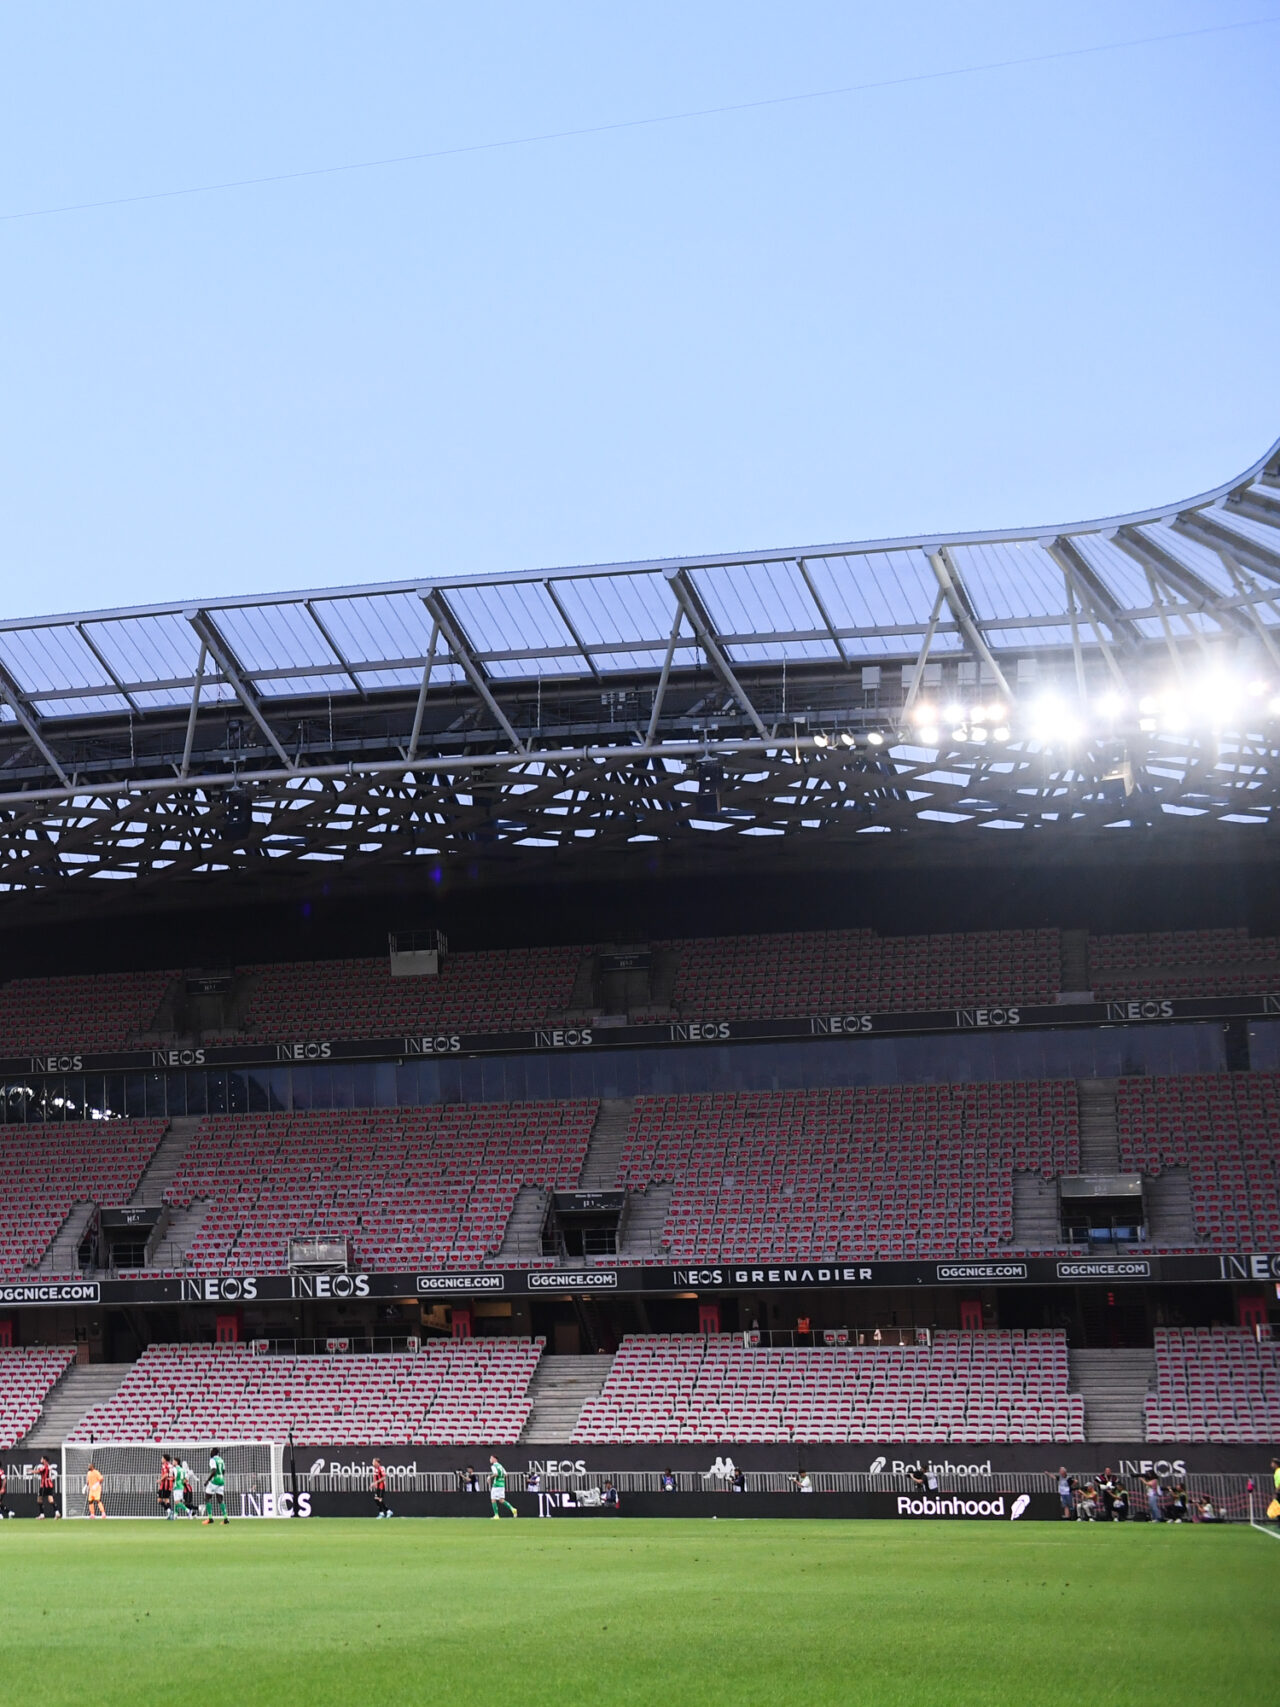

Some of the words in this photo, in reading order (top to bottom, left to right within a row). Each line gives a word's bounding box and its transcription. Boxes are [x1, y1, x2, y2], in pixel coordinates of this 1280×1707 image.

[955, 1008, 1020, 1026] INEOS
[1106, 1001, 1173, 1018] INEOS
[670, 1022, 730, 1040] INEOS
[810, 1015, 873, 1033] INEOS
[404, 1035, 461, 1052] INEOS
[534, 1029, 593, 1046] INEOS
[152, 1049, 205, 1066] INEOS
[276, 1042, 331, 1059] INEOS
[31, 1056, 83, 1072] INEOS
[673, 1270, 722, 1285] INEOS
[736, 1268, 872, 1282] GRENADIER
[941, 1265, 1023, 1278] OGCNICE.COM
[1061, 1264, 1145, 1275] OGCNICE.COM
[180, 1277, 258, 1300] INEOS
[290, 1274, 370, 1297] INEOS
[420, 1276, 500, 1289] OGCNICE.COM
[532, 1273, 613, 1287] OGCNICE.COM
[529, 1460, 586, 1476] INEOS
[897, 1496, 1004, 1515] Robinhood
